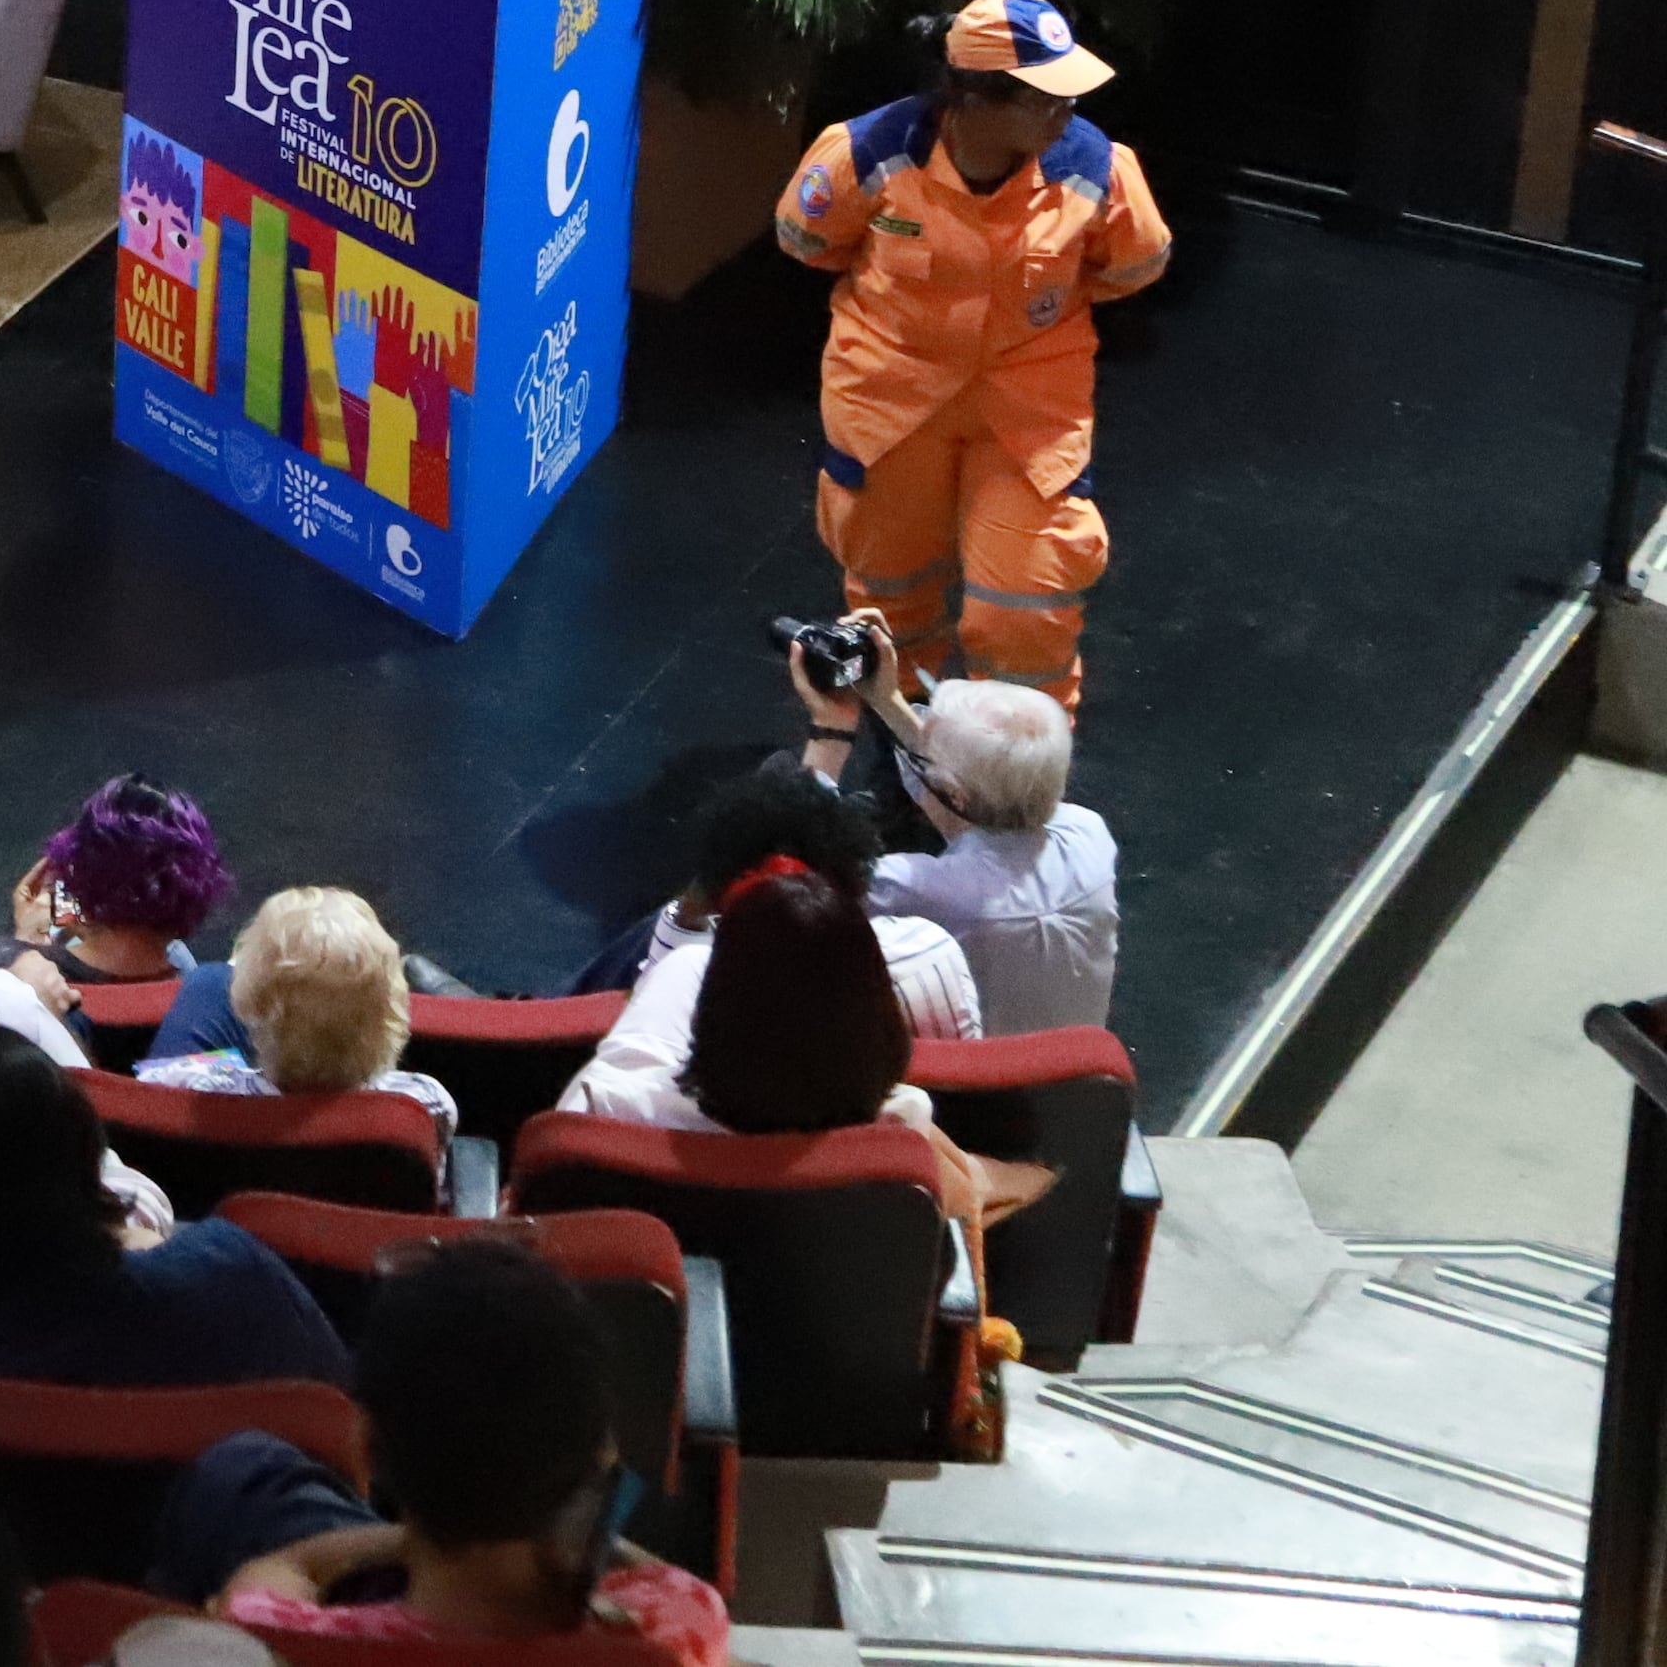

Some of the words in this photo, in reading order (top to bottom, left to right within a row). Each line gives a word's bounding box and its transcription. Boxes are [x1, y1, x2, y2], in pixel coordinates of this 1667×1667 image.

[280, 126, 416, 209] INTERNACIONAL
[281, 108, 348, 155] FESTIVAL
[347, 74, 437, 188] 10
[280, 147, 295, 164] DE
[297, 155, 415, 245] LITERATURA
[536, 199, 589, 279] Biblioteca
[133, 264, 178, 322] CALI
[124, 298, 185, 369] VALLE
[534, 301, 578, 388] Oiga
[145, 403, 168, 426] Valle
[170, 421, 185, 436] del
[526, 362, 569, 441] Mire
[527, 401, 561, 497] Lea
